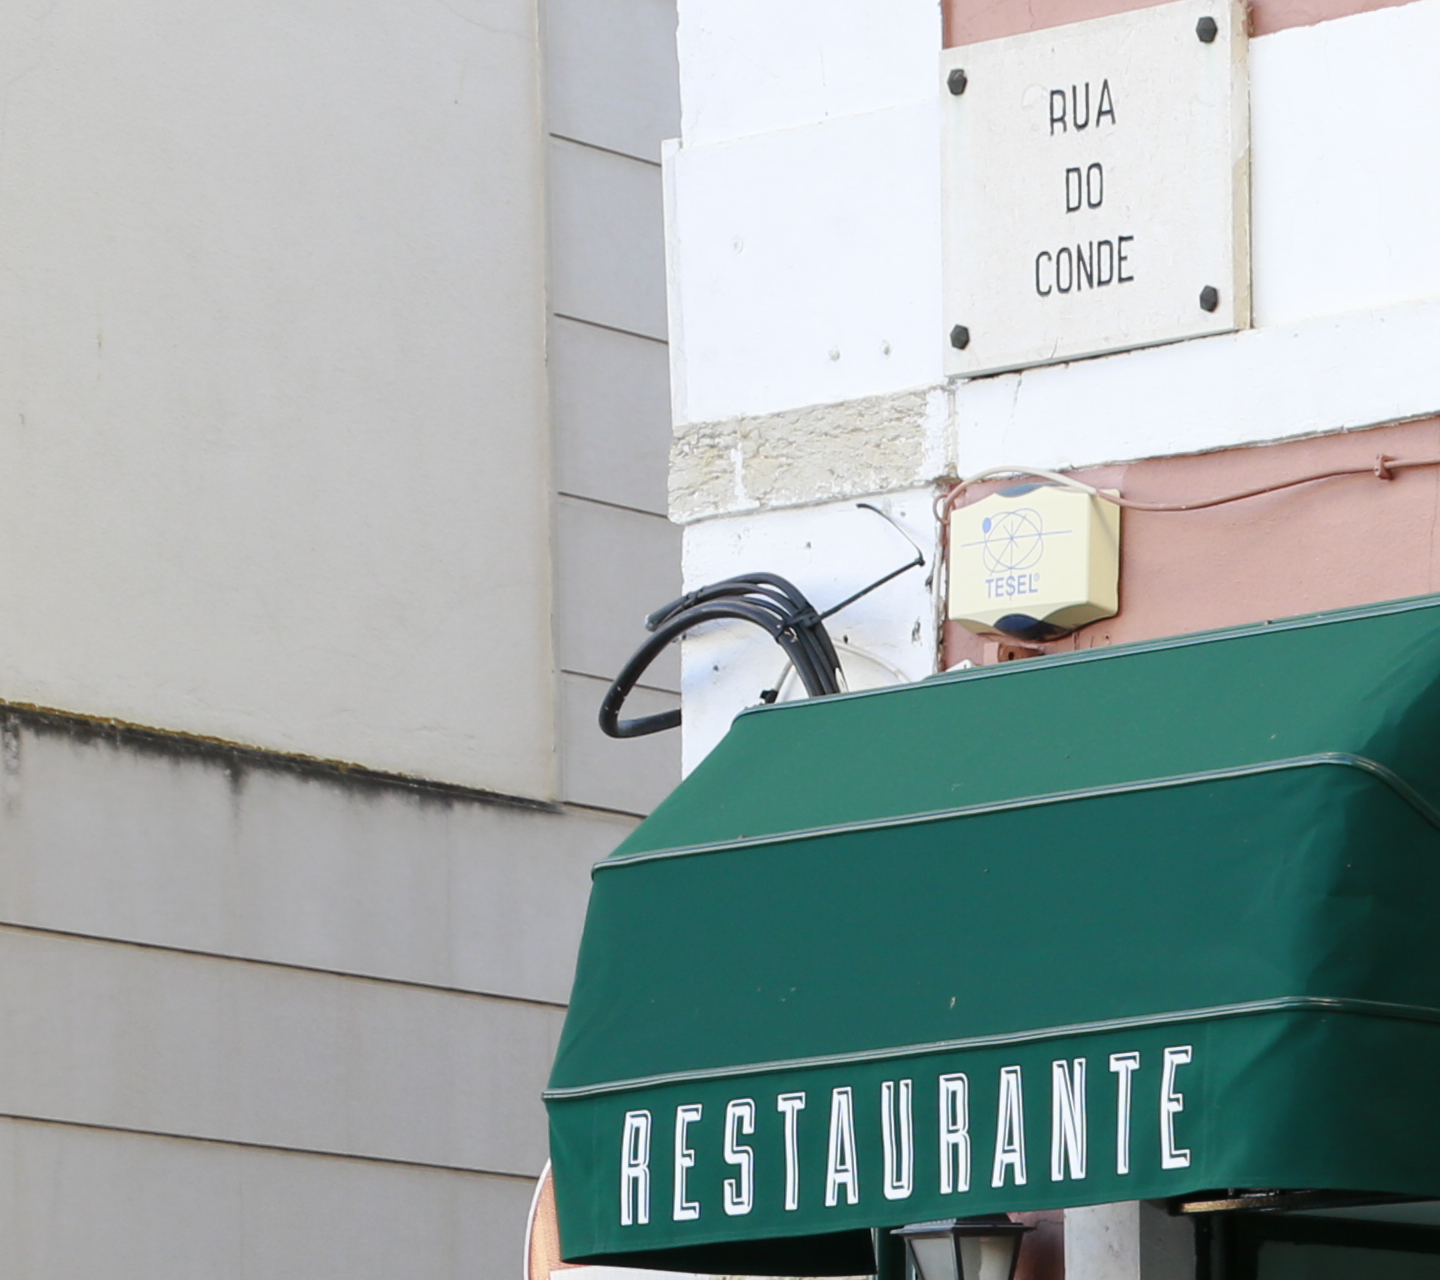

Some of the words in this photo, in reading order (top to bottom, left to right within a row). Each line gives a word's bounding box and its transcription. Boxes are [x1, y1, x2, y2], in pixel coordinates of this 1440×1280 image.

[1049, 79, 1116, 136] RUA
[1065, 162, 1104, 213] DO
[1035, 235, 1134, 297] CONDE
[619, 1045, 1193, 1227] RESTAURANTE
